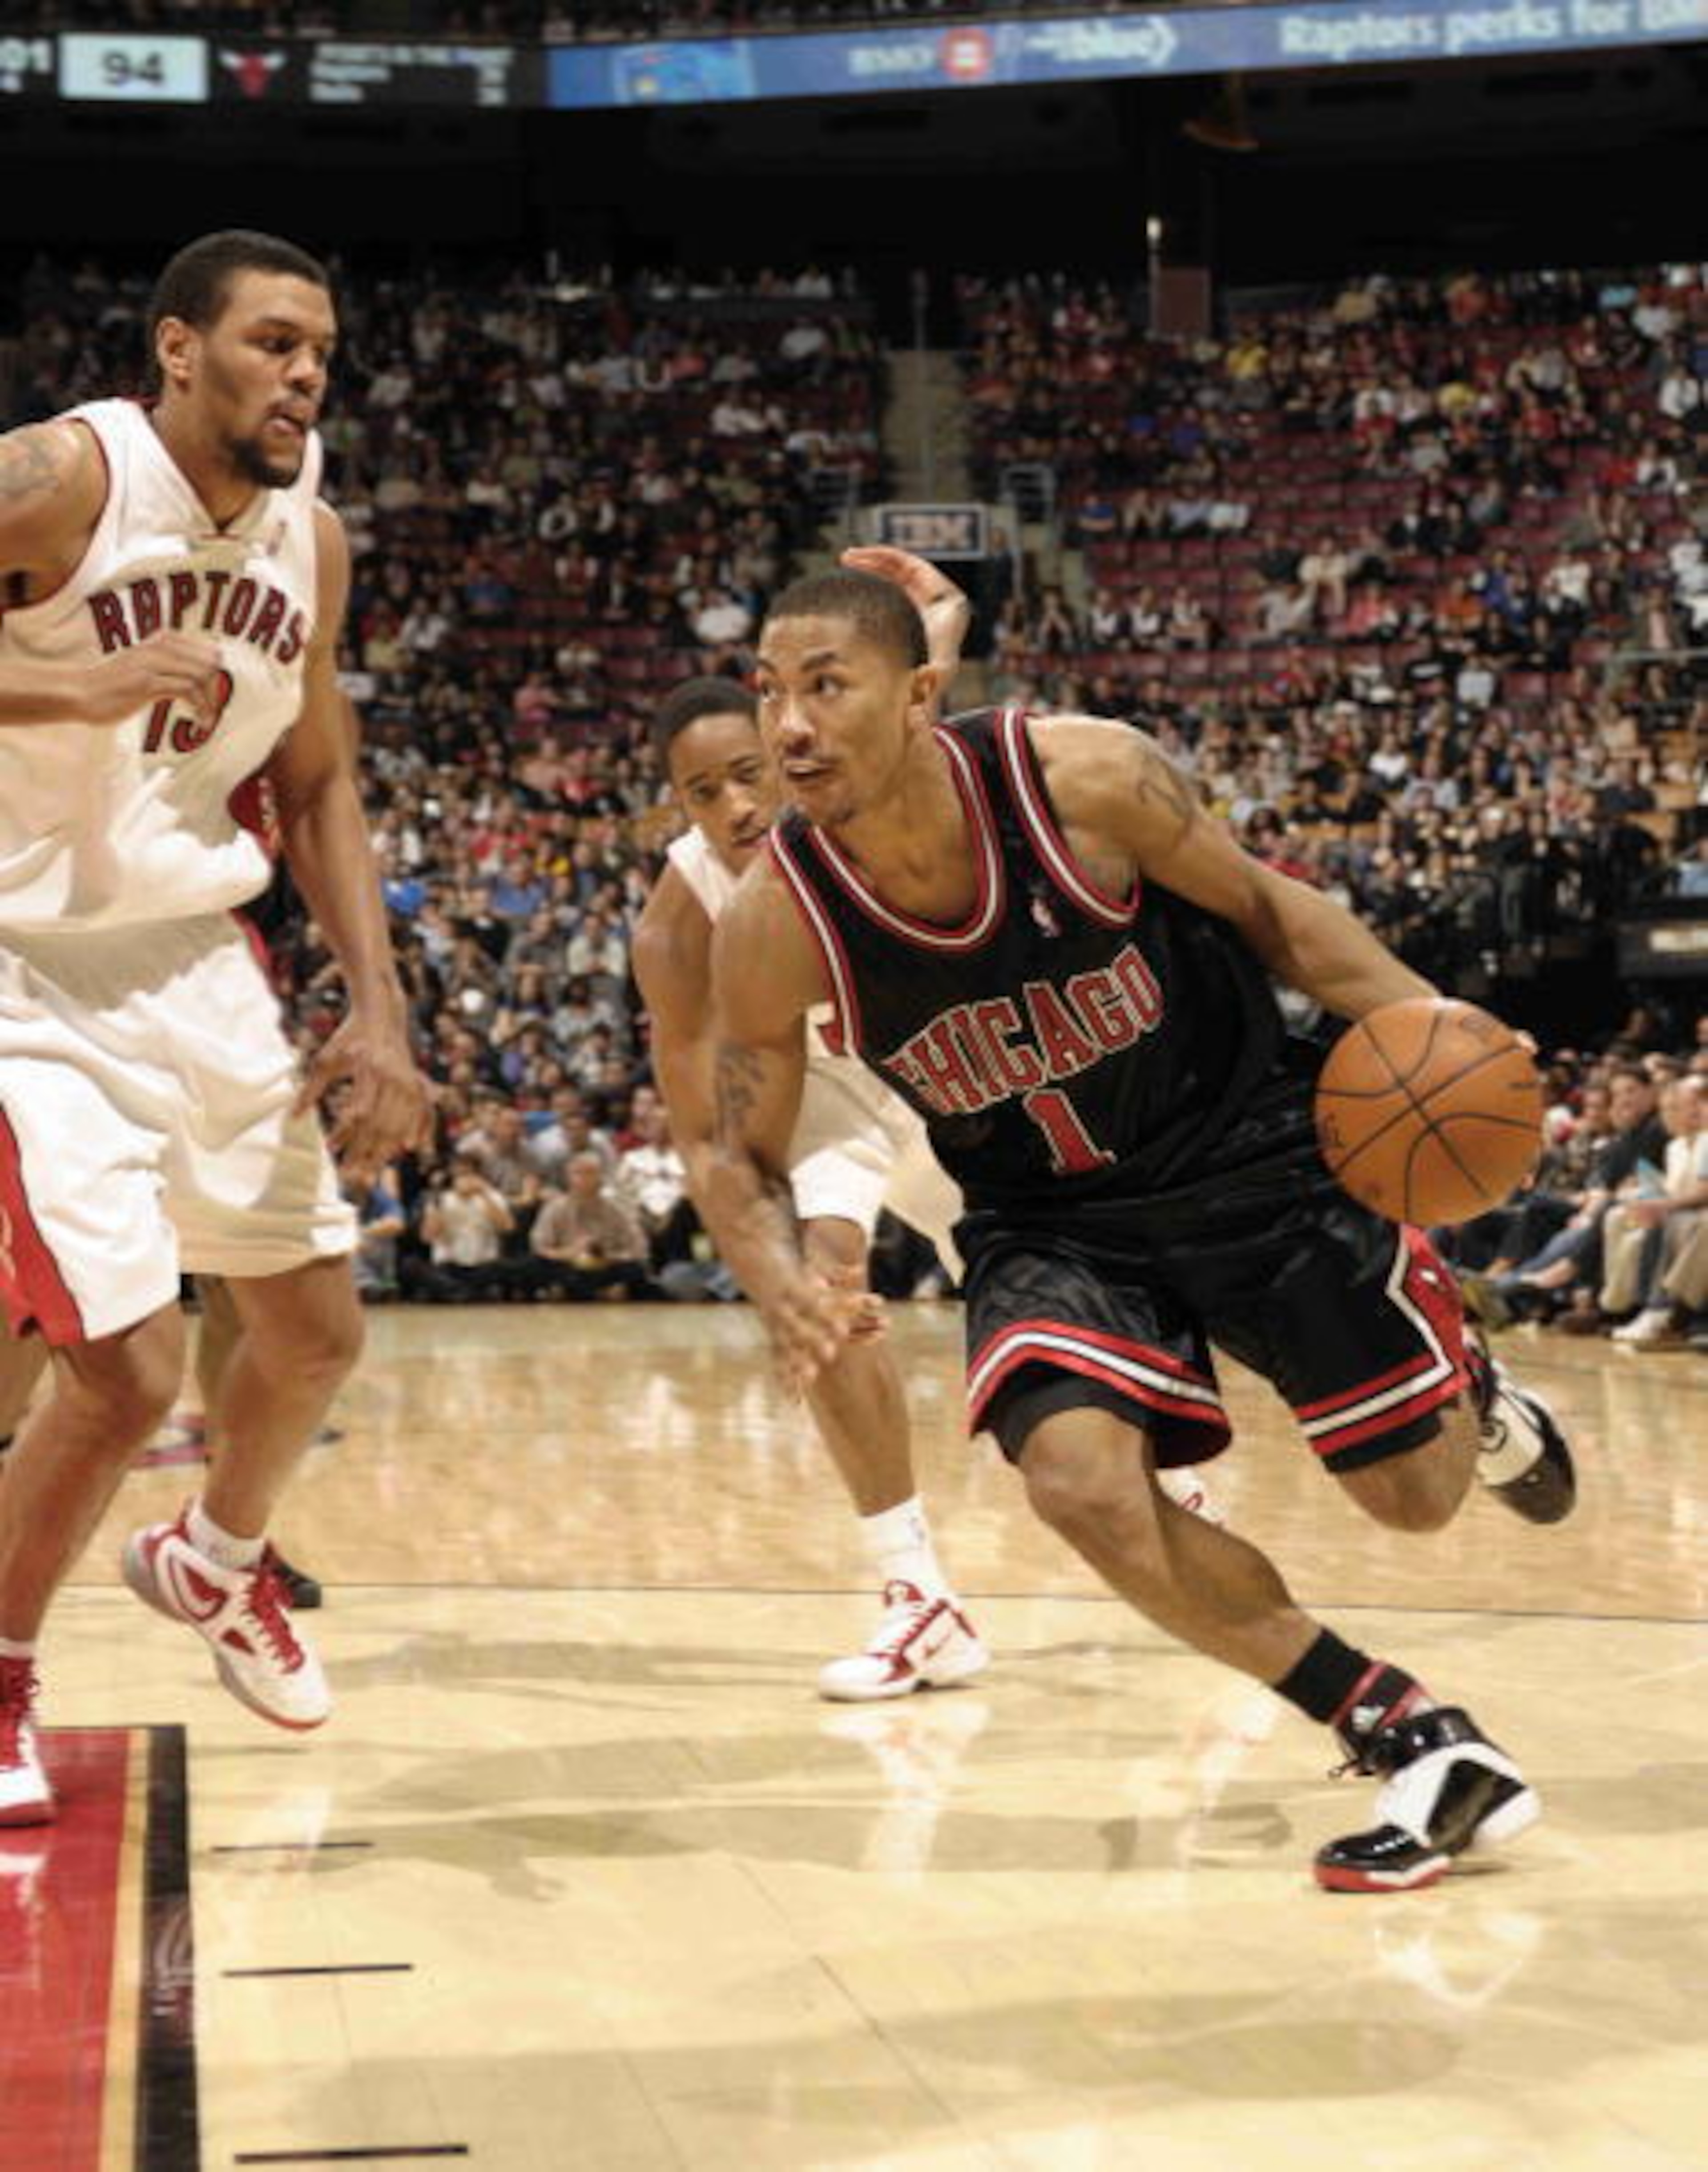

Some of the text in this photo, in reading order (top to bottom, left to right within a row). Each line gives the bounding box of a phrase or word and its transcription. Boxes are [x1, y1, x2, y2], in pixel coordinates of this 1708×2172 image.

[101, 51, 165, 87] 94
[1282, 14, 1436, 62] Raptors
[1446, 0, 1560, 56] perks
[1572, 0, 1629, 34] for
[88, 570, 305, 665] RAPTORS
[879, 942, 1165, 1115] CHICAGO
[1022, 1089, 1117, 1175] 1
